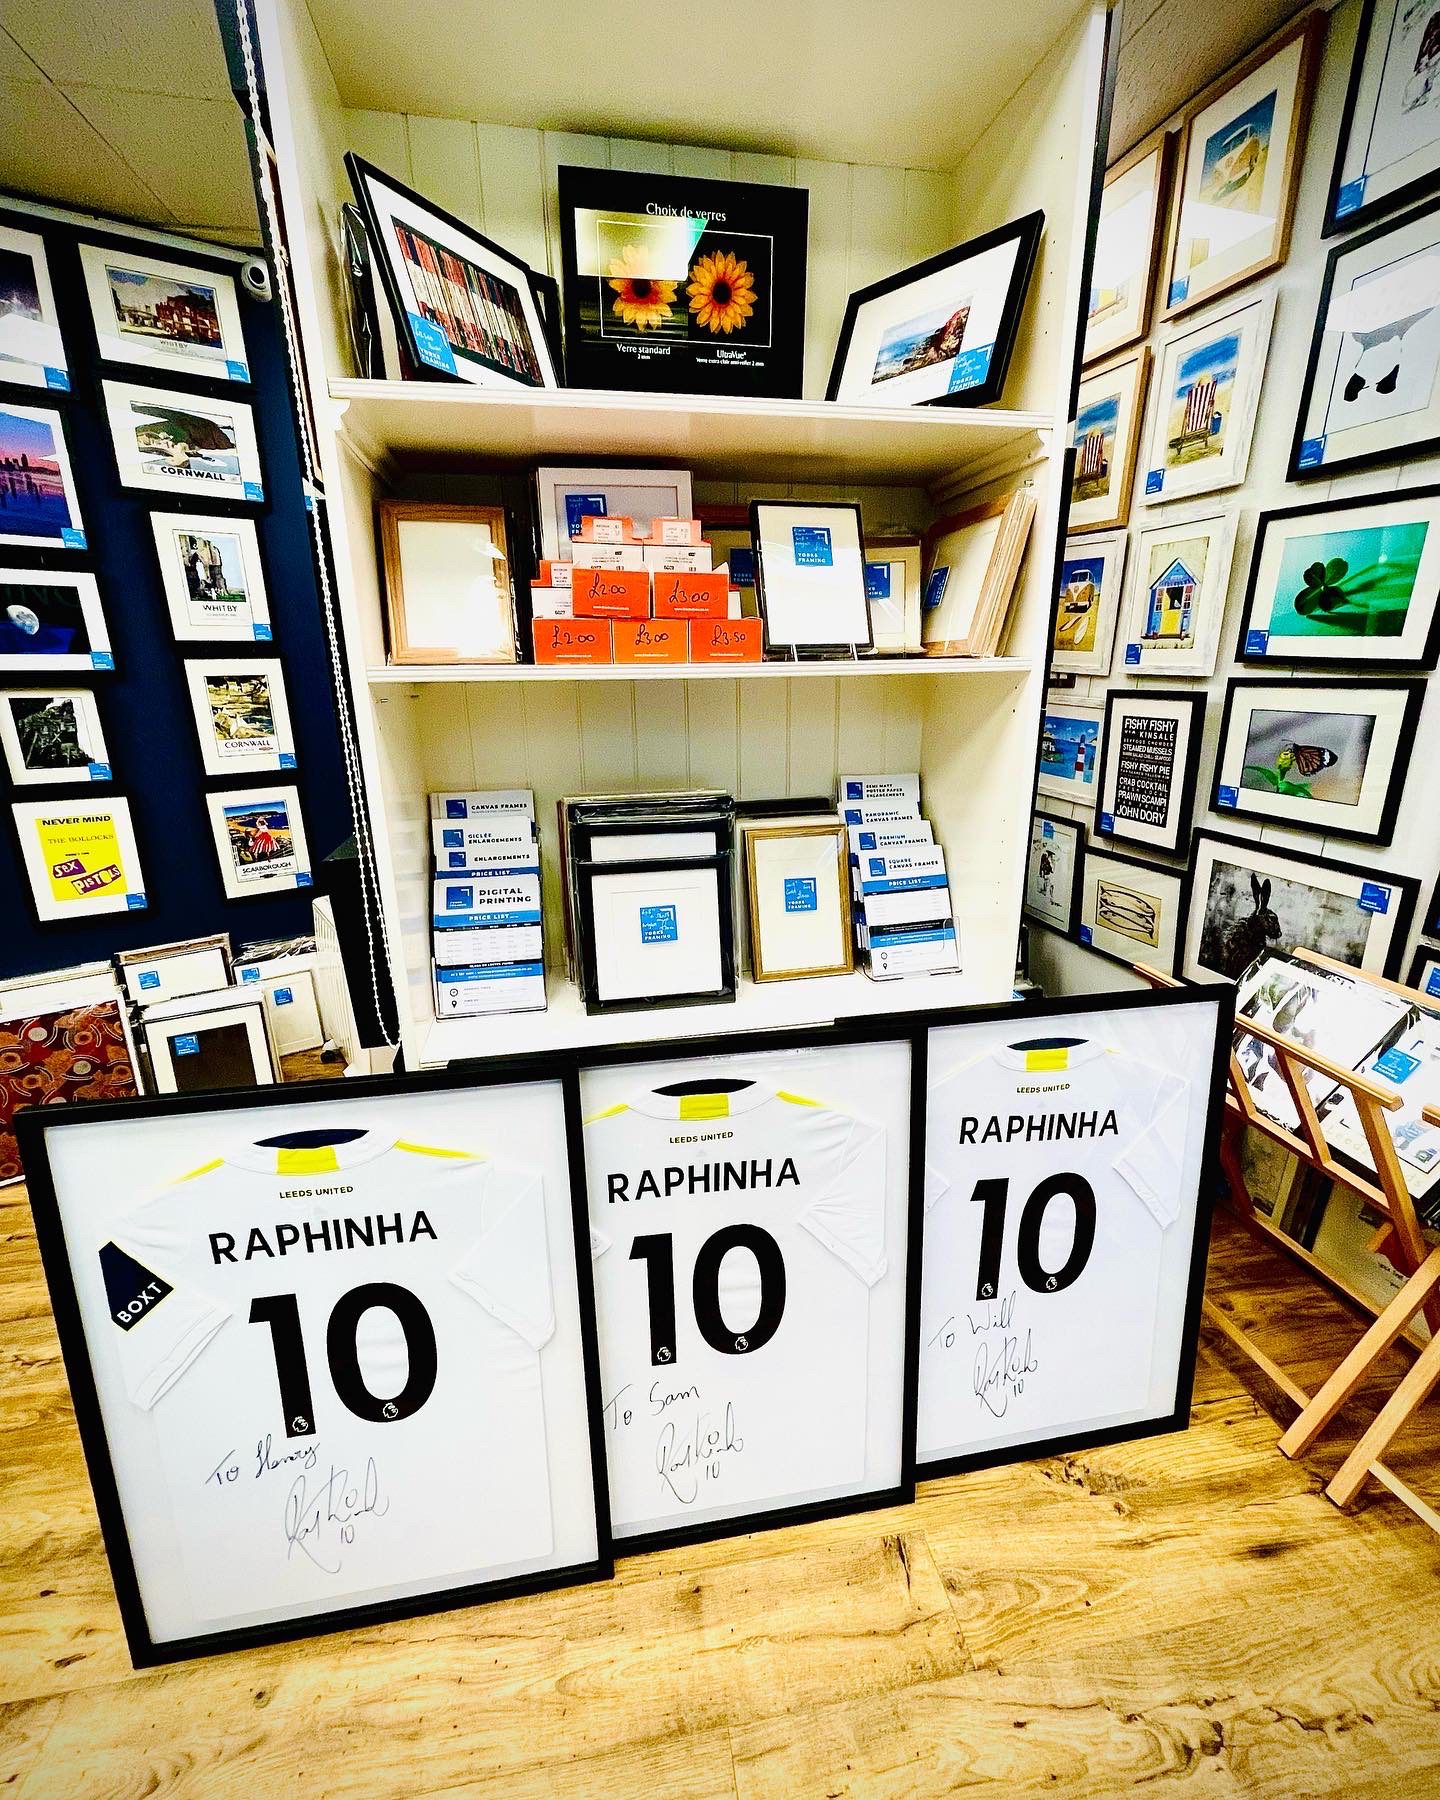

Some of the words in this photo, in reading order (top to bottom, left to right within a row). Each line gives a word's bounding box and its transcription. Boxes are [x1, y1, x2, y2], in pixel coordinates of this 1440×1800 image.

[646, 202, 677, 217] Choix
[680, 206, 693, 218] de
[695, 209, 726, 222] verres
[616, 343, 636, 354] Verre
[638, 344, 671, 355] standard
[161, 466, 225, 481] CORNWALL
[588, 573, 627, 599] £2.00
[203, 604, 238, 612] WHITBY
[551, 625, 595, 648] £2.00
[635, 624, 669, 646] £3.00
[711, 625, 746, 647] £3.50
[1124, 718, 1148, 730] FISHY
[1149, 720, 1175, 732] FISHY
[1139, 731, 1174, 741] KINSALE
[224, 740, 270, 749] CORNWALL
[1122, 744, 1146, 753] STEAMED
[1147, 746, 1173, 756] MUSSELS
[1121, 761, 1138, 770] FISHY
[1139, 763, 1158, 773] FISHY
[1159, 766, 1170, 775] PIE
[1119, 777, 1135, 786] CRAB
[1136, 780, 1168, 792] COCKTAIL
[1118, 790, 1141, 802] PRAWN
[1141, 794, 1166, 807] SCAMPI
[42, 817, 80, 826] NEVER
[82, 815, 111, 823] MIND
[1117, 804, 1139, 819] JOHN
[1140, 810, 1164, 824] DORY
[68, 834, 114, 843] BOLLOCKS
[242, 862, 292, 874] SCARBOROUGH
[479, 887, 523, 896] DIGITAL
[479, 896, 532, 905] PRINTING
[1016, 1086, 1041, 1095] LEEDS
[1042, 1083, 1071, 1093] UNITED
[959, 1109, 1119, 1145] RAPHINHA
[669, 1133, 699, 1144] LEEDS
[700, 1131, 734, 1142] UNITED
[607, 1157, 801, 1204] RAPHINHA
[279, 1188, 313, 1199] LEEDS
[315, 1186, 354, 1197] UNITED
[208, 1210, 438, 1265] RAPHINHA
[969, 1172, 1097, 1302] 10
[116, 1281, 162, 1323] BOXT
[628, 1223, 787, 1367] 10
[966, 1290, 1016, 1335] Will
[248, 1282, 438, 1439] 10
[649, 1381, 700, 1416] Sam
[340, 1524, 355, 1544] 10
